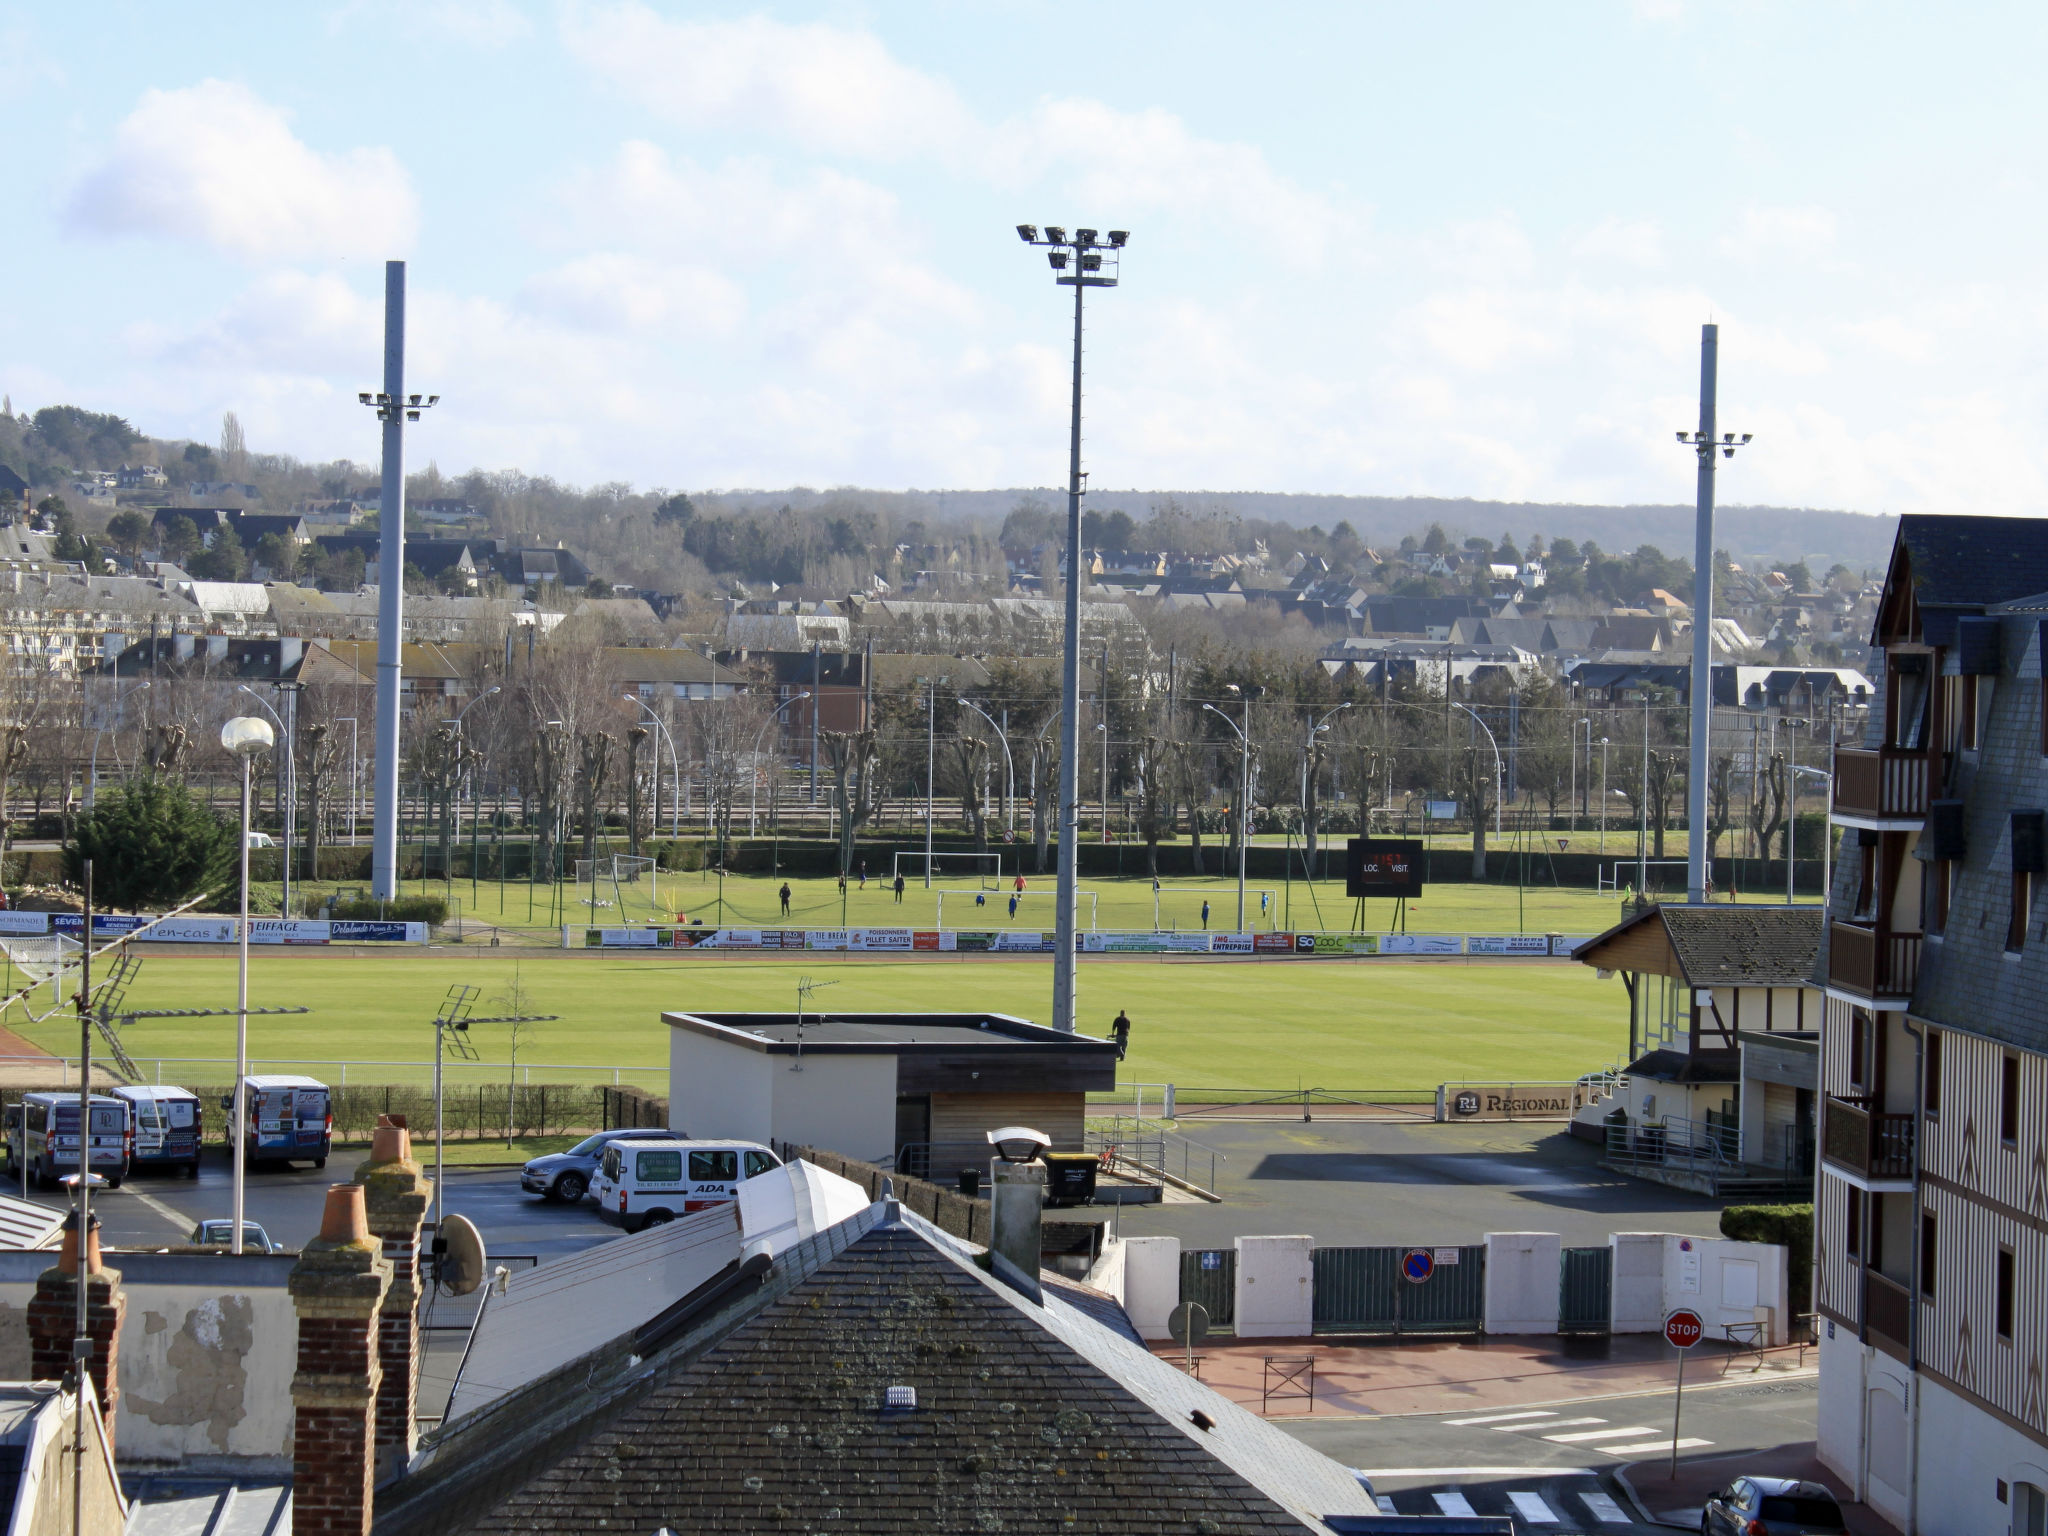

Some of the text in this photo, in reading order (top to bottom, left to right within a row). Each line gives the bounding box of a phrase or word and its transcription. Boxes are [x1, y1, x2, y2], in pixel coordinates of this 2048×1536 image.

[1363, 864, 1409, 873] LOC. VISIT.
[256, 921, 299, 932] EIFFAGE
[829, 931, 848, 939] BREAK
[1213, 943, 1252, 951] ENTREPRISE
[1459, 1097, 1478, 1109] R1
[1487, 1095, 1570, 1111] RÉGIONAL
[1574, 1093, 1583, 1109] 1
[695, 1184, 725, 1193] ADA
[1669, 1323, 1699, 1336] STOP
